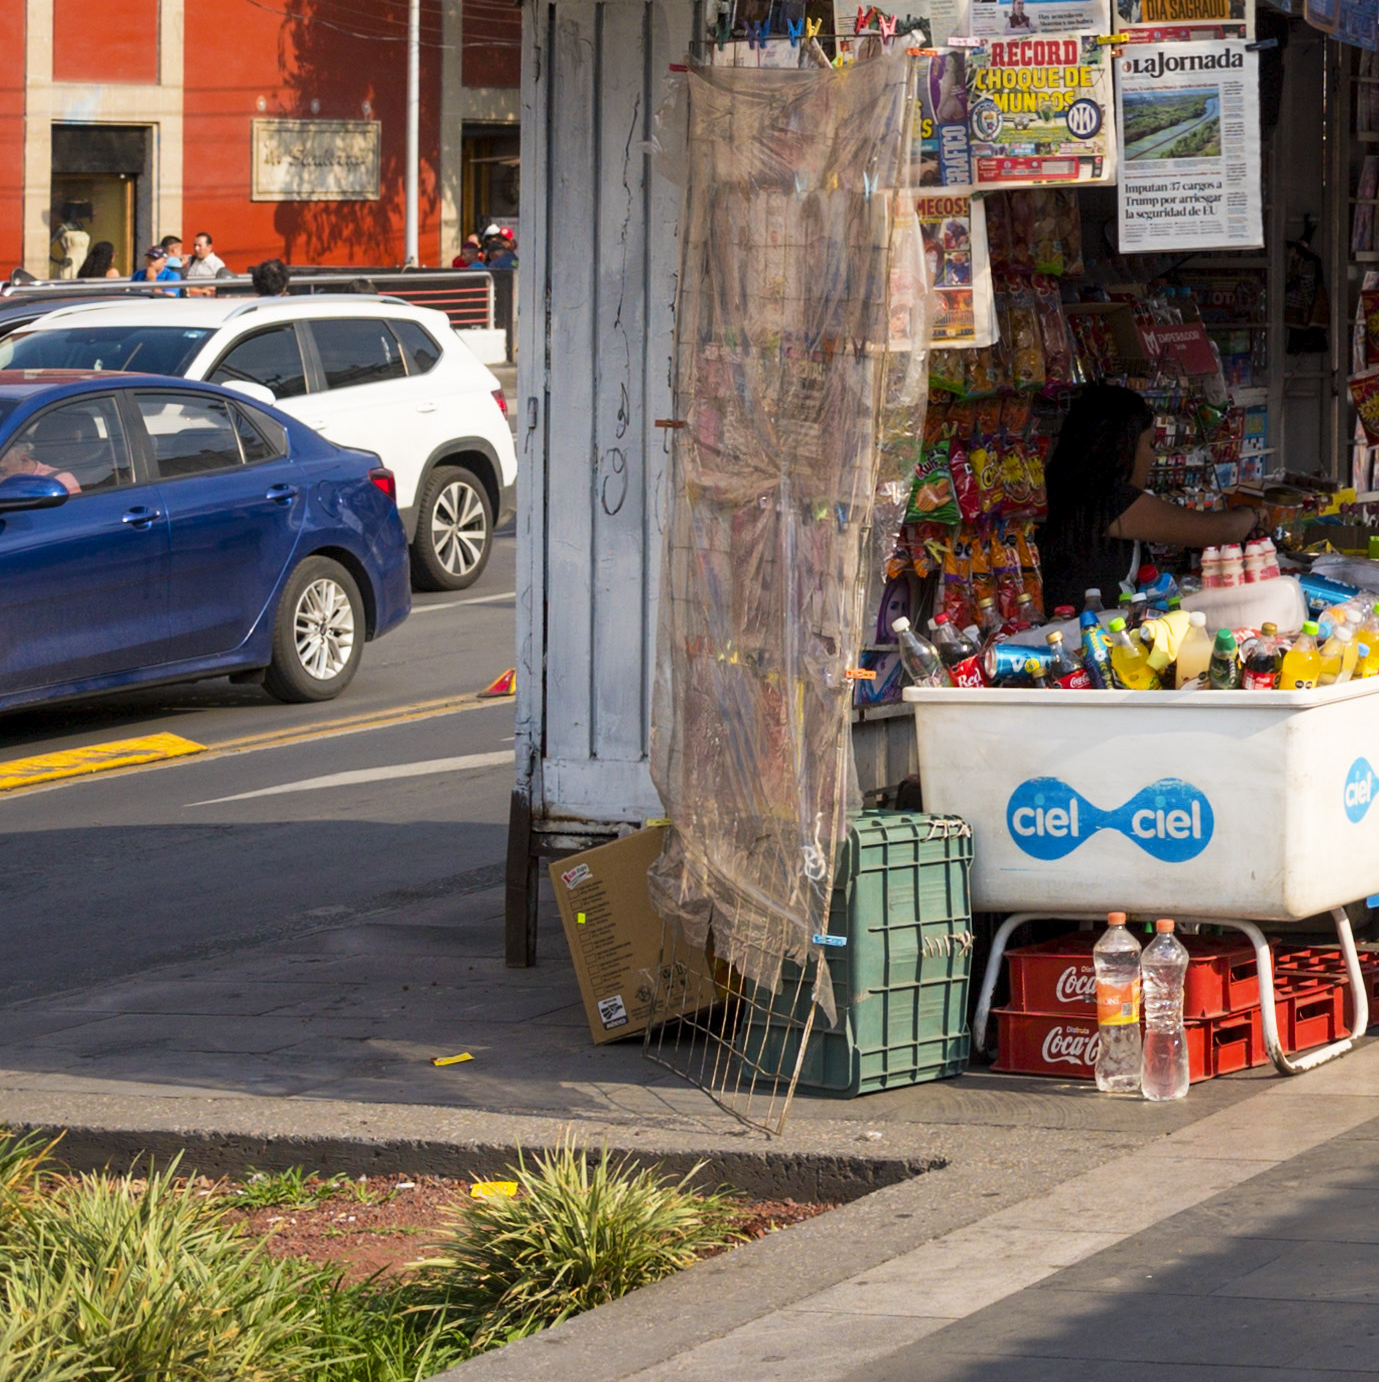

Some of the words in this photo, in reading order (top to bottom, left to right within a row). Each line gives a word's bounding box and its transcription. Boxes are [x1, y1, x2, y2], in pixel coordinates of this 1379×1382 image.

[976, 67, 1060, 92] CHOQUE
[1064, 66, 1093, 88] DE
[993, 91, 1075, 113] MUNDOS
[1125, 183, 1167, 194] Imputan
[1169, 182, 1180, 191] 37
[1182, 182, 1215, 192] cargos
[1125, 195, 1158, 207] Trump
[1160, 196, 1176, 206] por
[1179, 193, 1222, 205] arriesgar
[1125, 210, 1134, 219] la
[1136, 207, 1186, 220] seguridad
[1188, 206, 1201, 216] de
[1203, 205, 1217, 215] EU
[1344, 770, 1371, 806] ciel
[1013, 793, 1079, 837] ciel
[1131, 795, 1201, 840] ciel
